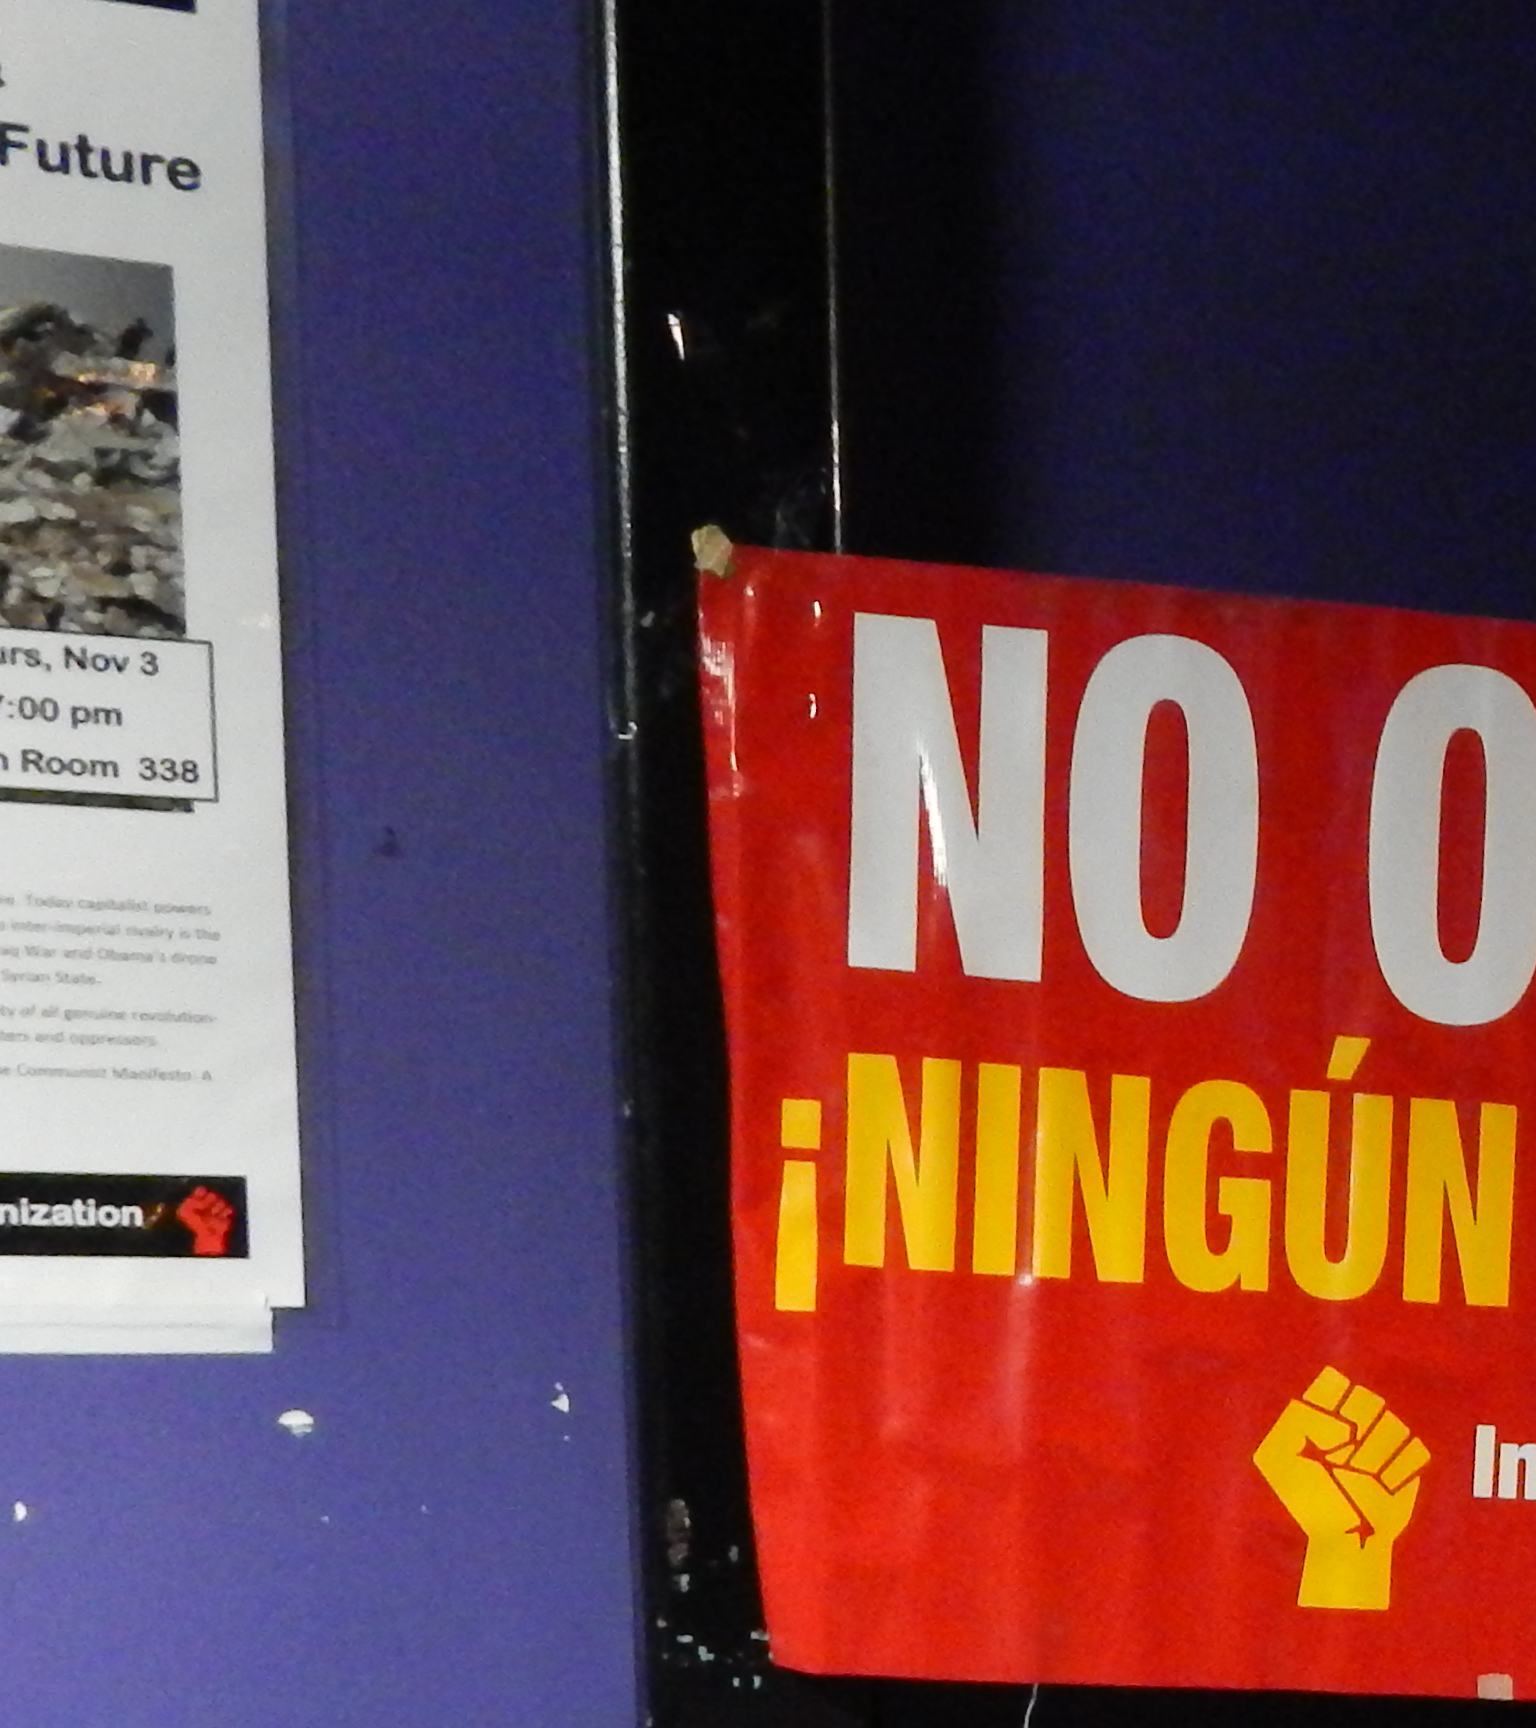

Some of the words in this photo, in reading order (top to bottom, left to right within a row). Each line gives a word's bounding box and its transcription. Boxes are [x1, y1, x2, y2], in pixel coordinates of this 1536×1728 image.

[0, 122, 202, 191] Future
[64, 645, 129, 673] Nov
[140, 651, 160, 676] 3
[71, 704, 123, 730] pm
[21, 748, 120, 777] Room
[138, 757, 199, 783] 338
[848, 612, 1259, 1002] NO
[775, 1036, 1517, 1311] ¡NINGÚN
